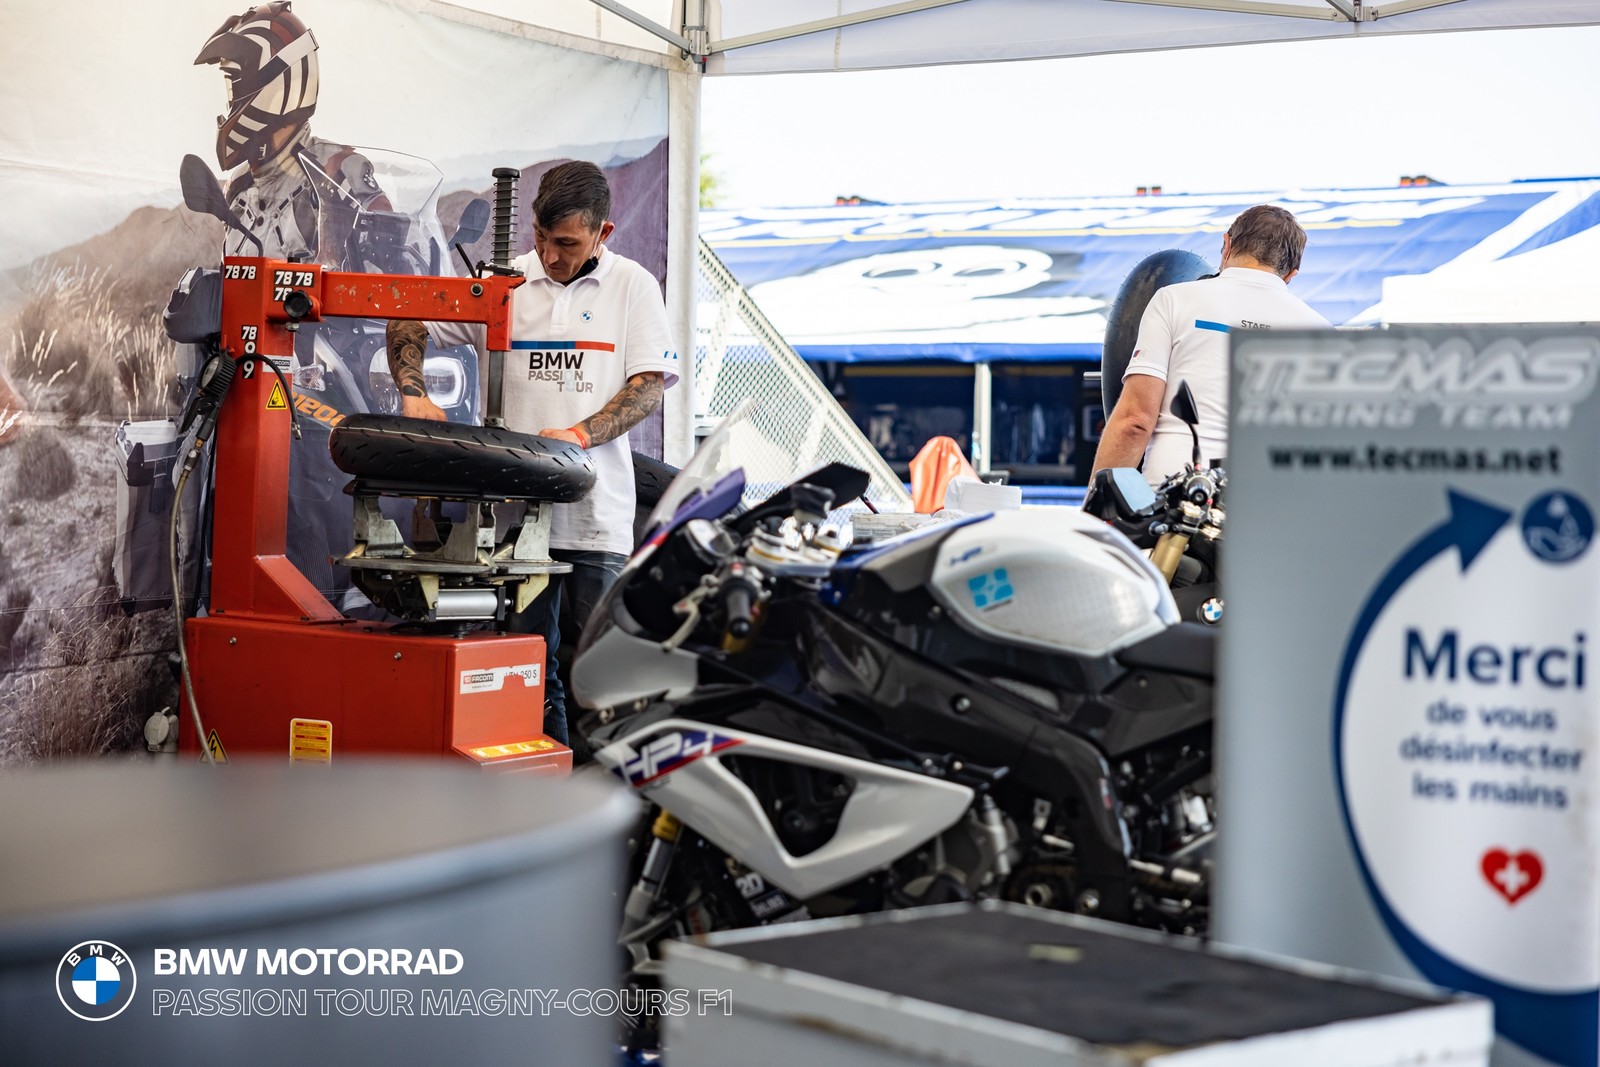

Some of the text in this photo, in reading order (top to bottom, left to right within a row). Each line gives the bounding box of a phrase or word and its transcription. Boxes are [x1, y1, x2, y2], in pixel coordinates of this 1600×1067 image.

[225, 265, 257, 279] 78 78
[275, 271, 314, 286] 78 78
[242, 326, 257, 340] 78
[243, 360, 255, 379] 9
[529, 352, 584, 370] BMW
[1240, 346, 1594, 396] TECMAS
[528, 370, 583, 381] PASSION
[557, 381, 594, 393] TOUR
[1240, 404, 1574, 431] RACING TEAM
[1270, 443, 1563, 474] www.tecmas.net
[1404, 628, 1586, 690] Merci
[1427, 699, 1557, 731] de vous
[615, 729, 716, 787] HP4
[1400, 733, 1584, 772] désinfecter
[1412, 771, 1568, 809] les mains
